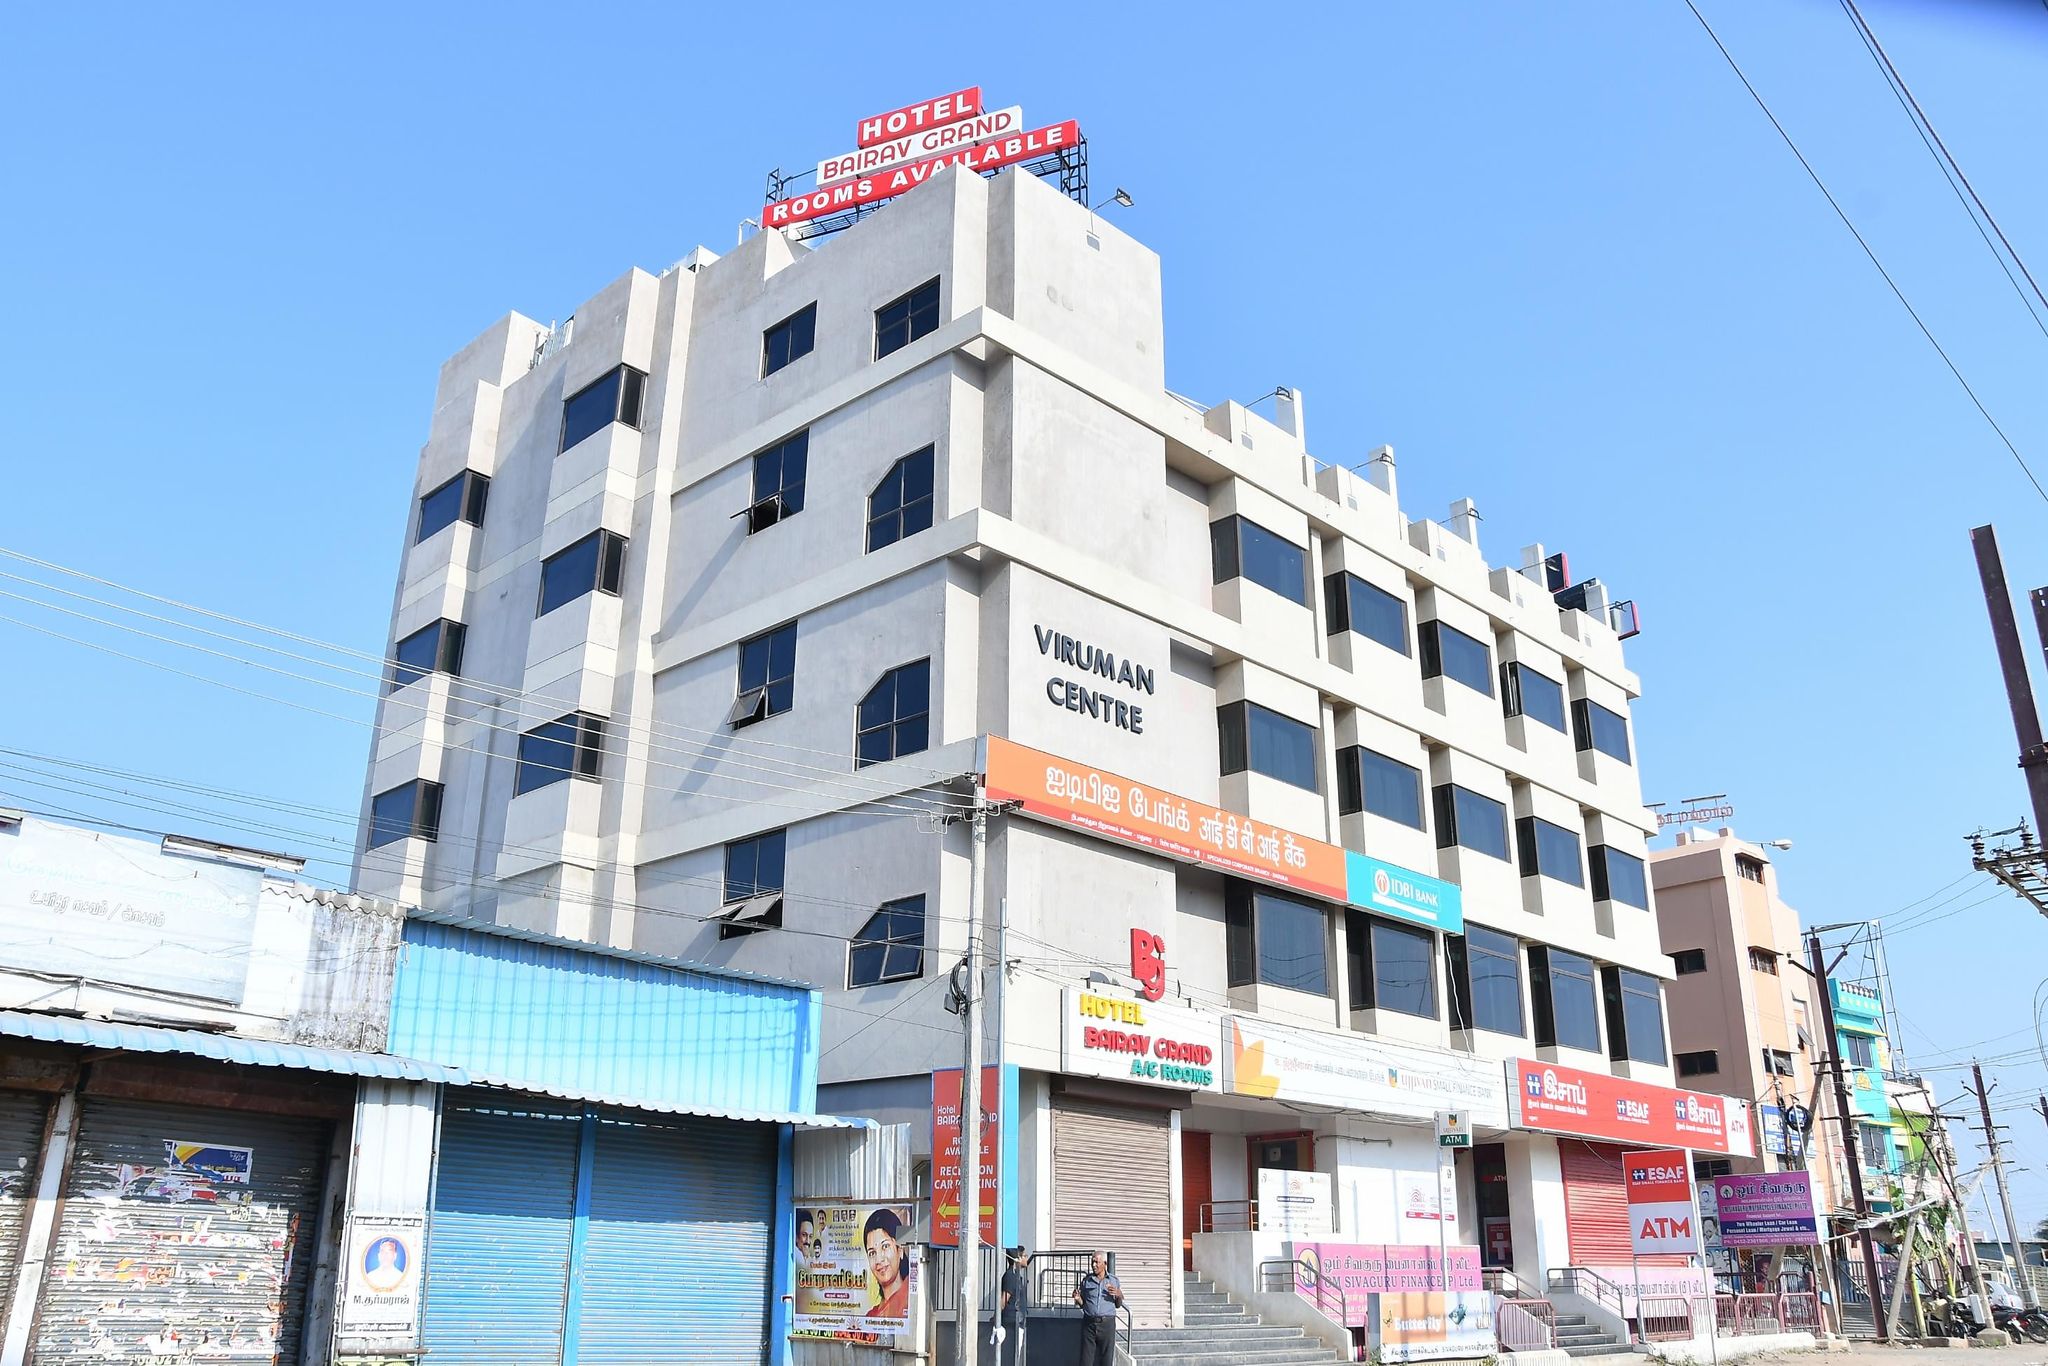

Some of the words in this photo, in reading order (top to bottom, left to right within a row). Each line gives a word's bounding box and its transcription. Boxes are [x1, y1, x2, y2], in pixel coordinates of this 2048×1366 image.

[863, 93, 973, 141] HOTEL
[823, 138, 913, 180] BAIRAV
[921, 112, 1012, 150] GRAND
[772, 180, 873, 221] ROOMS
[1034, 623, 1155, 695] VIRUMAN
[1046, 676, 1143, 735] CENTRE
[1046, 766, 1120, 813] ஐடிபிஐ
[1128, 786, 1190, 832] பேங்க்
[1199, 812, 1224, 851] आई
[1225, 816, 1238, 850] डी
[1241, 820, 1255, 855] बी
[1257, 829, 1280, 867] आई
[1283, 833, 1306, 869] बैंक
[1391, 878, 1414, 899] IDBI
[1415, 888, 1439, 907] BANK
[1079, 993, 1146, 1025] HOTEL
[1084, 1026, 1150, 1057] BAIRAV
[1154, 1038, 1213, 1066] GRAND
[1130, 1058, 1159, 1078] A/C
[1160, 1063, 1213, 1086] ROOMS
[937, 1104, 956, 1115] Hotel
[1626, 1100, 1649, 1118] ESAF
[1731, 1120, 1745, 1133] ATM
[1445, 1136, 1462, 1144] ATM
[934, 1179, 953, 1190] CAR
[1647, 1166, 1684, 1180] ESAF
[1760, 1181, 1806, 1195] சிவகுரு
[1640, 1217, 1691, 1239] ATM
[1324, 1256, 1341, 1273] ஓம்
[1344, 1255, 1381, 1273] சிவகுரு
[1324, 1275, 1341, 1288] OM
[1344, 1275, 1397, 1288] SIVAGURU
[1400, 1275, 1443, 1288] FINANCE
[1394, 1315, 1441, 1332] Butterfly
